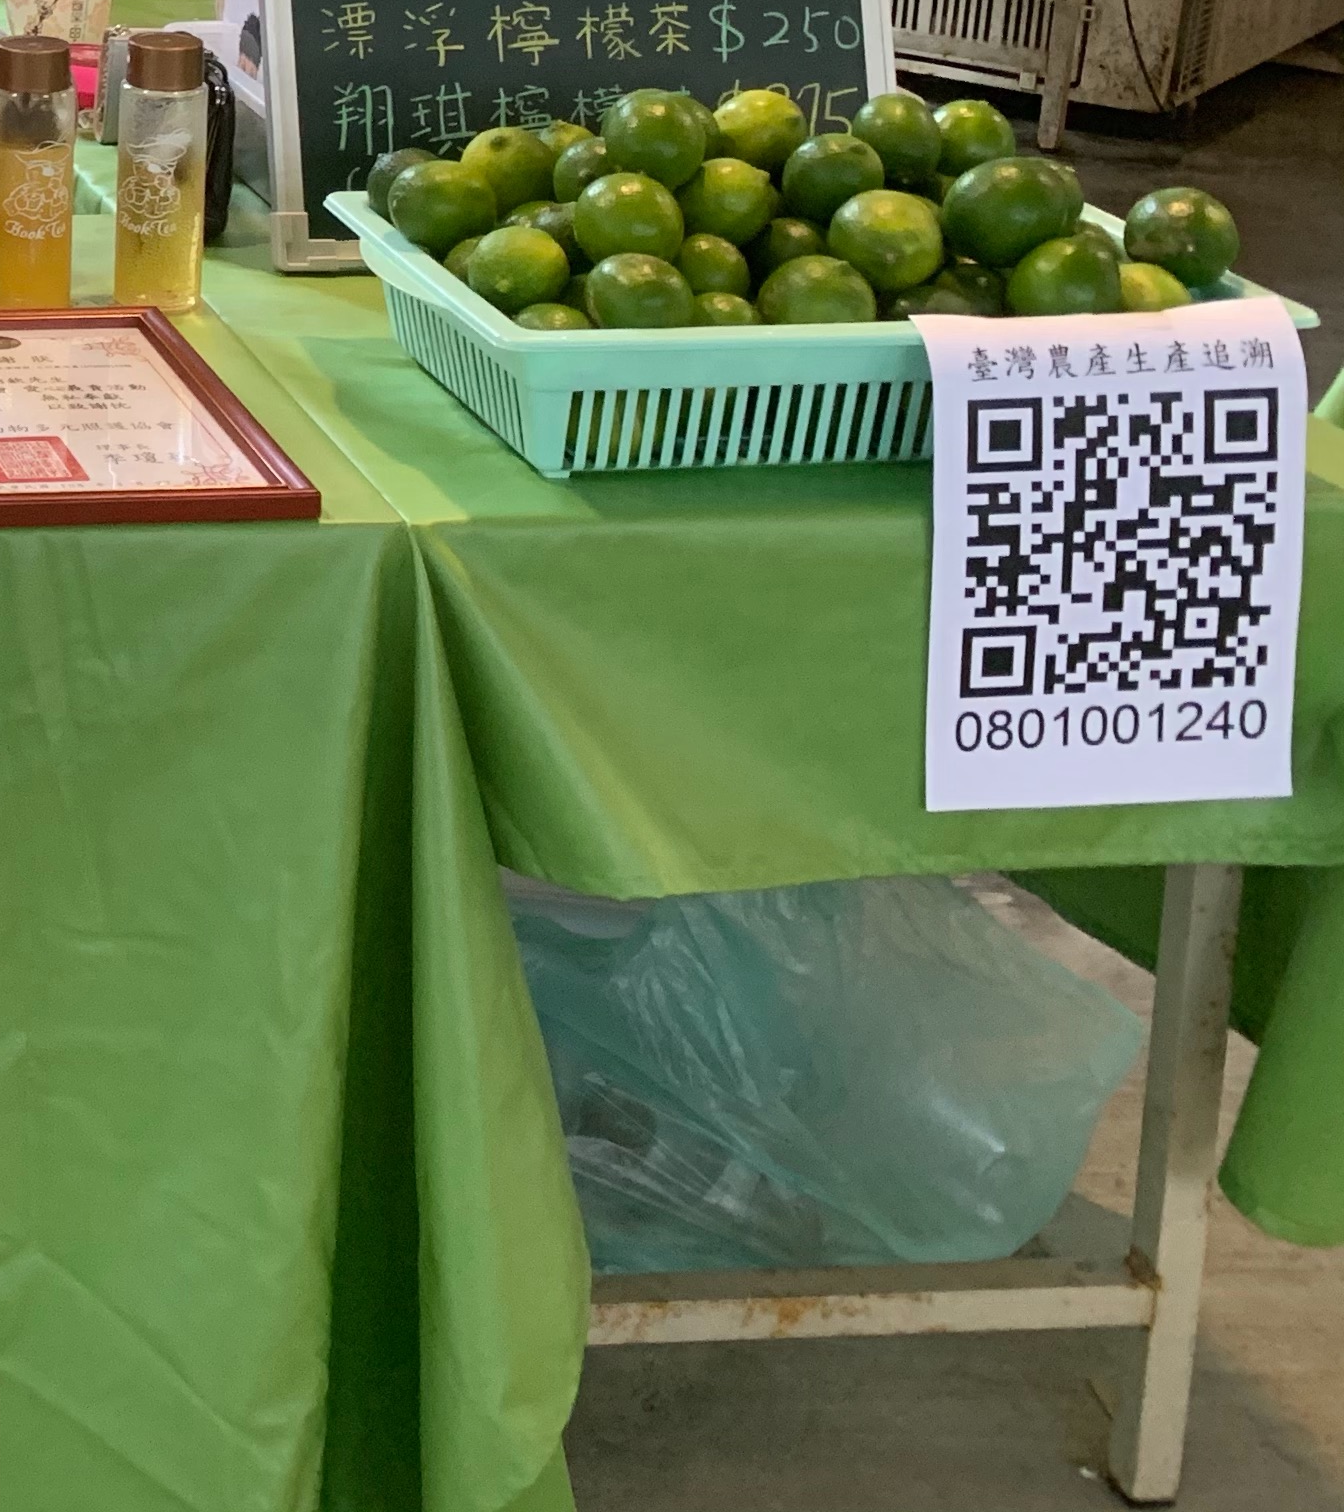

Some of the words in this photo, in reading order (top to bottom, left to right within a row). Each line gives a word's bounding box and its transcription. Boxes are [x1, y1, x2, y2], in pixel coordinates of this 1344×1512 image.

[320, 1, 692, 67] 漂浮檸檬茶
[967, 339, 1274, 382] 臺灣農產生產追溯
[955, 699, 1269, 752] 0801001240
